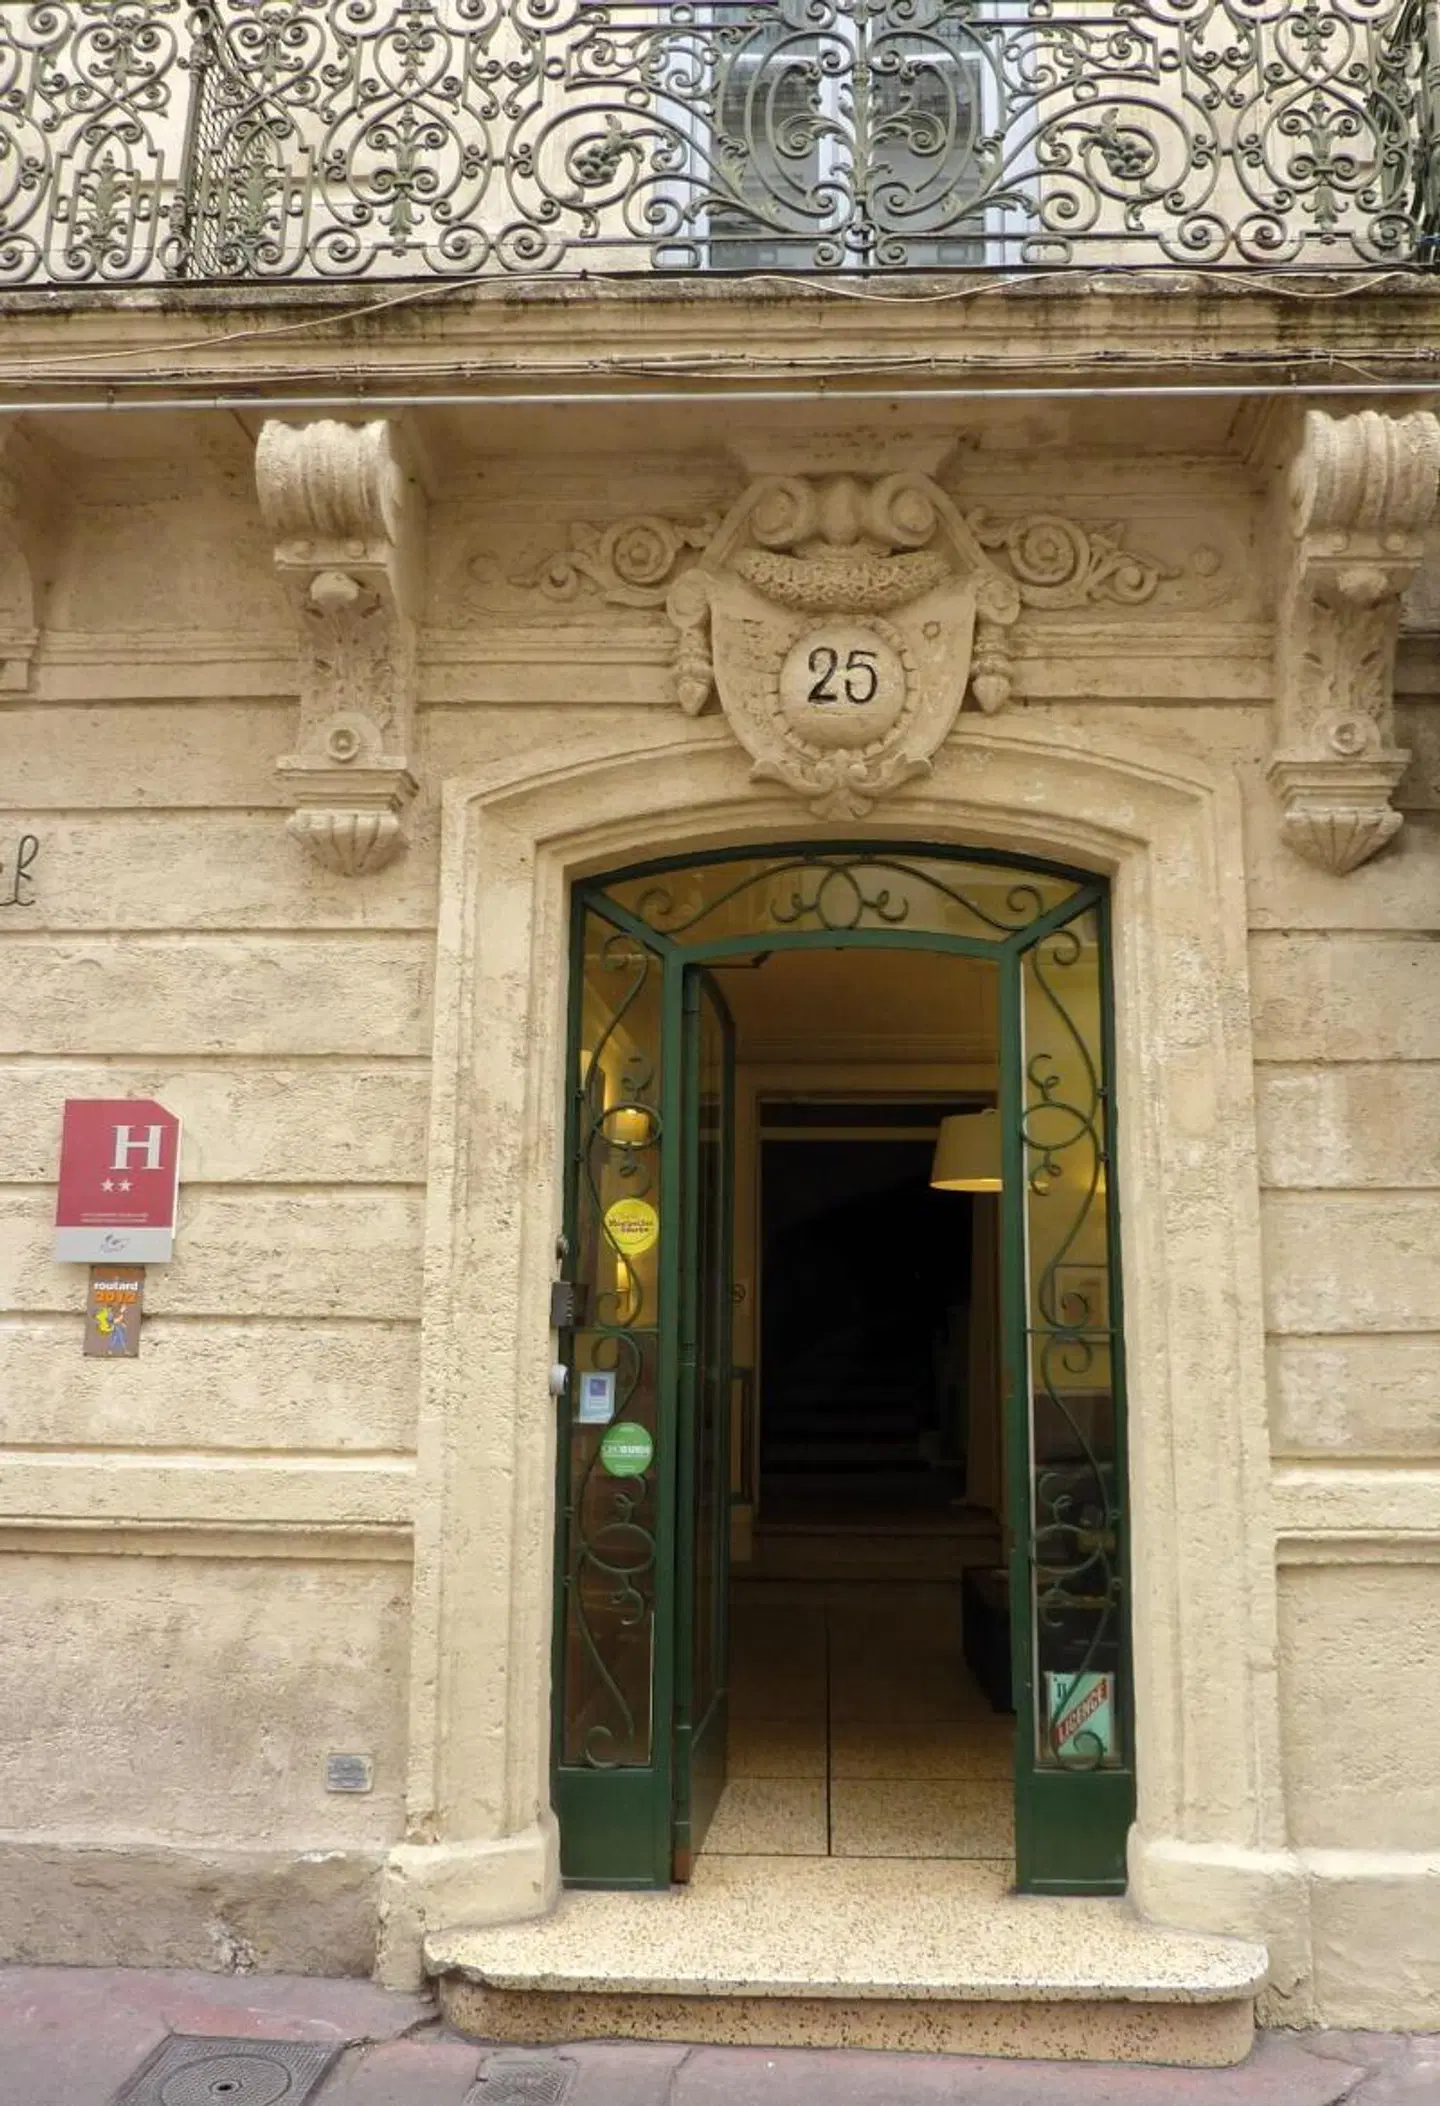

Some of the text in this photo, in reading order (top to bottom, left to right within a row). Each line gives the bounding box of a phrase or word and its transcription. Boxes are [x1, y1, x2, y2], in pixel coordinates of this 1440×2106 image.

[808, 646, 878, 704] 25
[109, 1125, 168, 1169] H
[94, 1281, 139, 1291] routard
[1057, 1680, 1107, 1745] LICENCE
